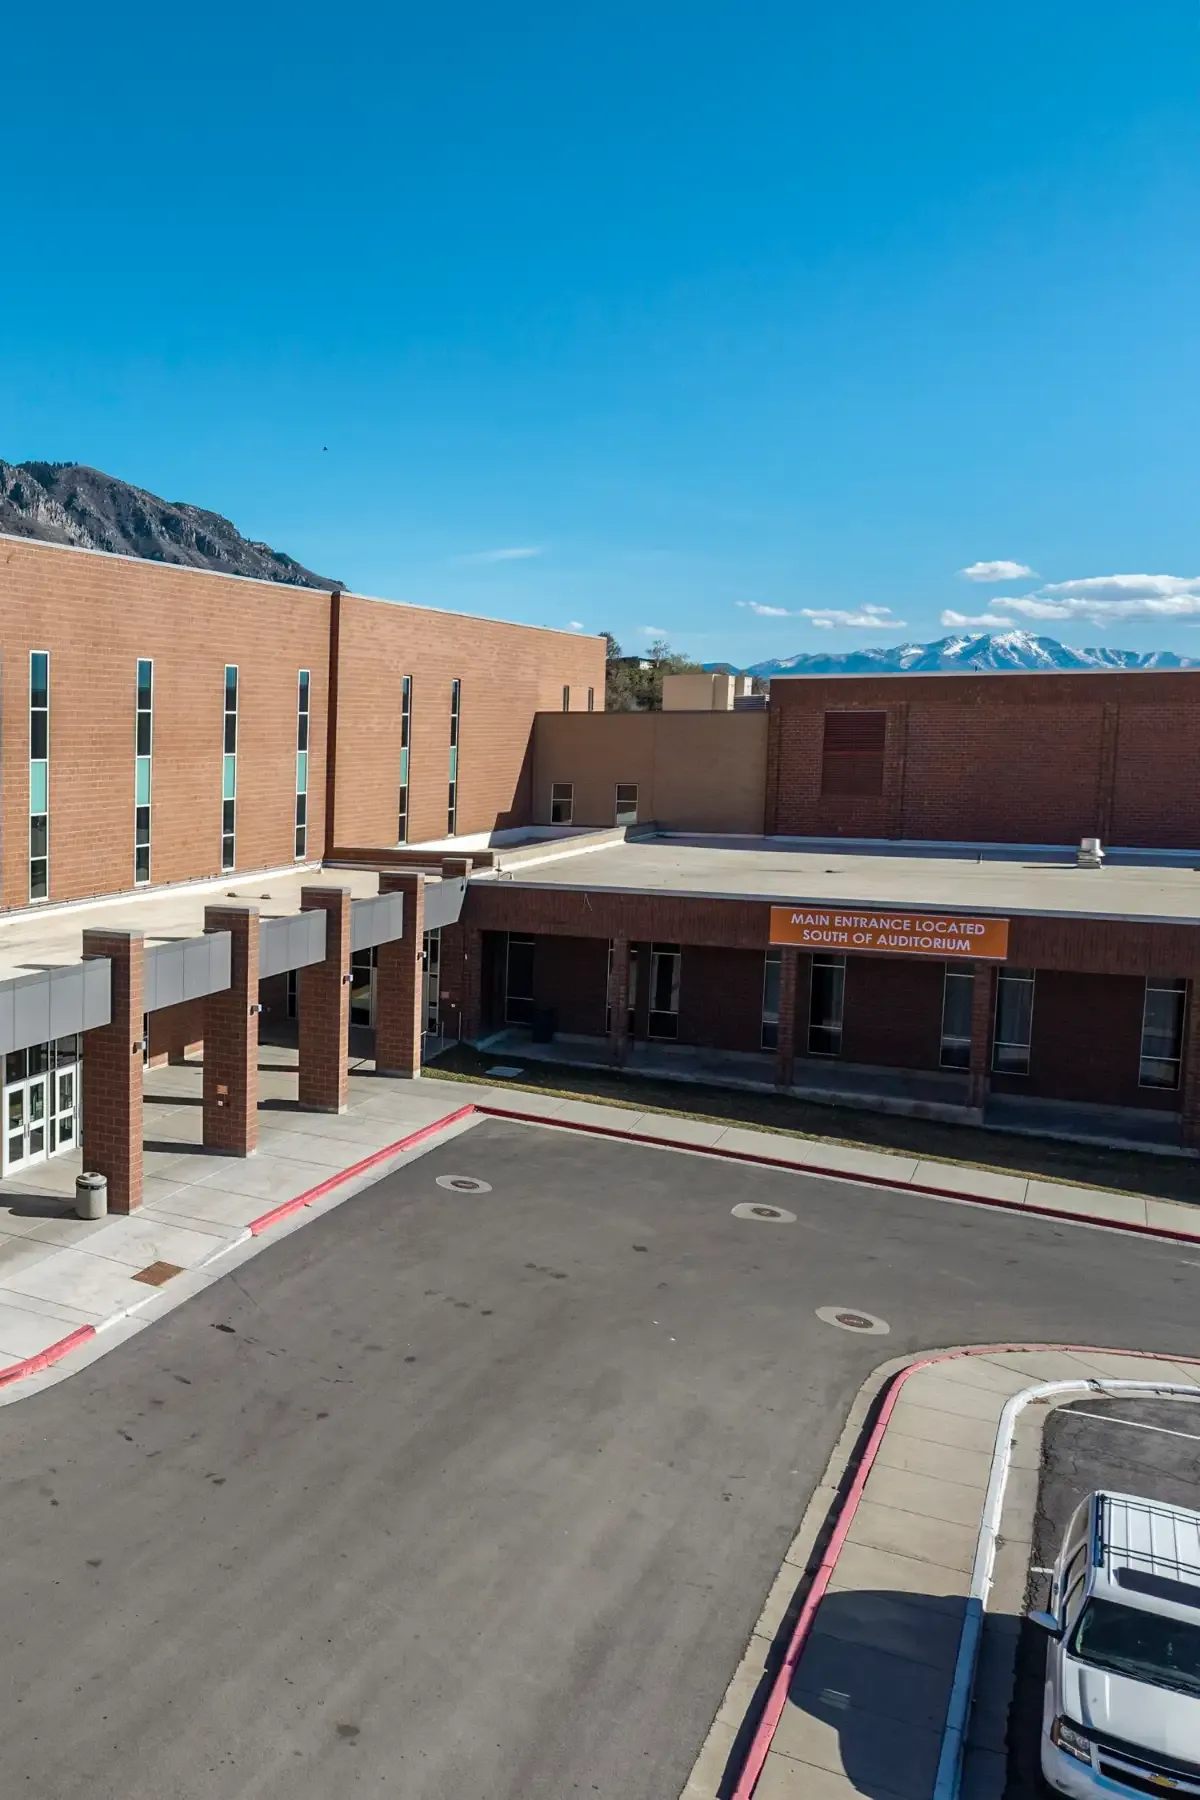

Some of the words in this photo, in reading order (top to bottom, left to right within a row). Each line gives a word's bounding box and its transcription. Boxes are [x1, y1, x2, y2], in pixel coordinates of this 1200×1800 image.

[791, 913, 830, 926] MAIN
[834, 915, 911, 931] ENTRANCE
[915, 920, 985, 935] LOCATED
[803, 929, 848, 943] SOUTH
[852, 932, 872, 944] OF
[877, 934, 970, 950] AUDITORIUM
